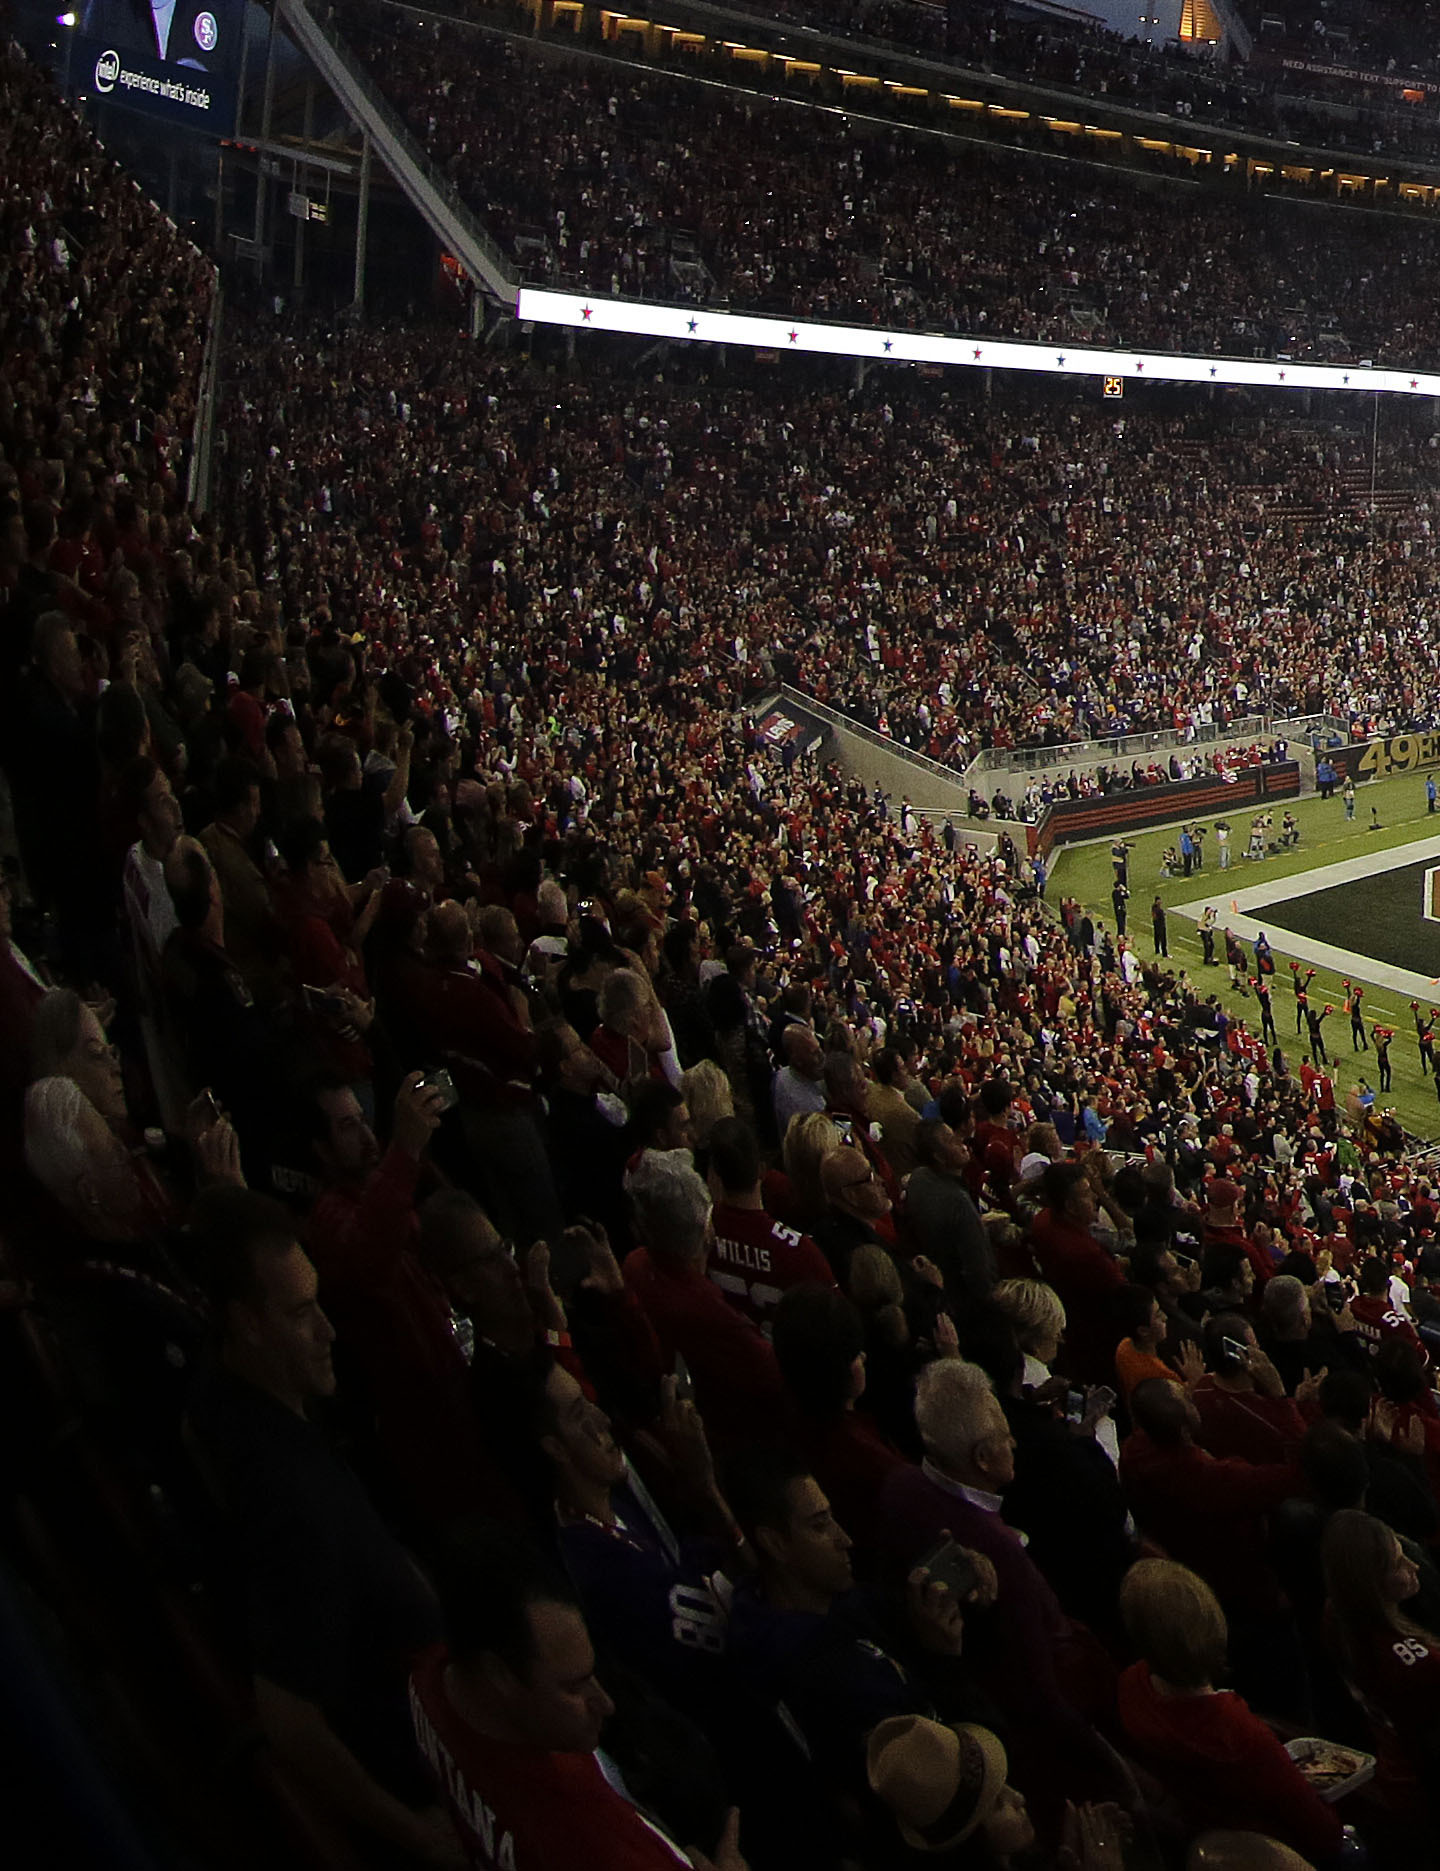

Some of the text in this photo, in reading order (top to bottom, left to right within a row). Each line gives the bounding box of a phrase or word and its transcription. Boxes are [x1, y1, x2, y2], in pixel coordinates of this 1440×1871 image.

[120, 69, 160, 95] experience
[184, 84, 210, 110] inside
[1104, 377, 1121, 395] 25
[714, 1235, 772, 1273] WILLIS
[1391, 1636, 1430, 1667] 85
